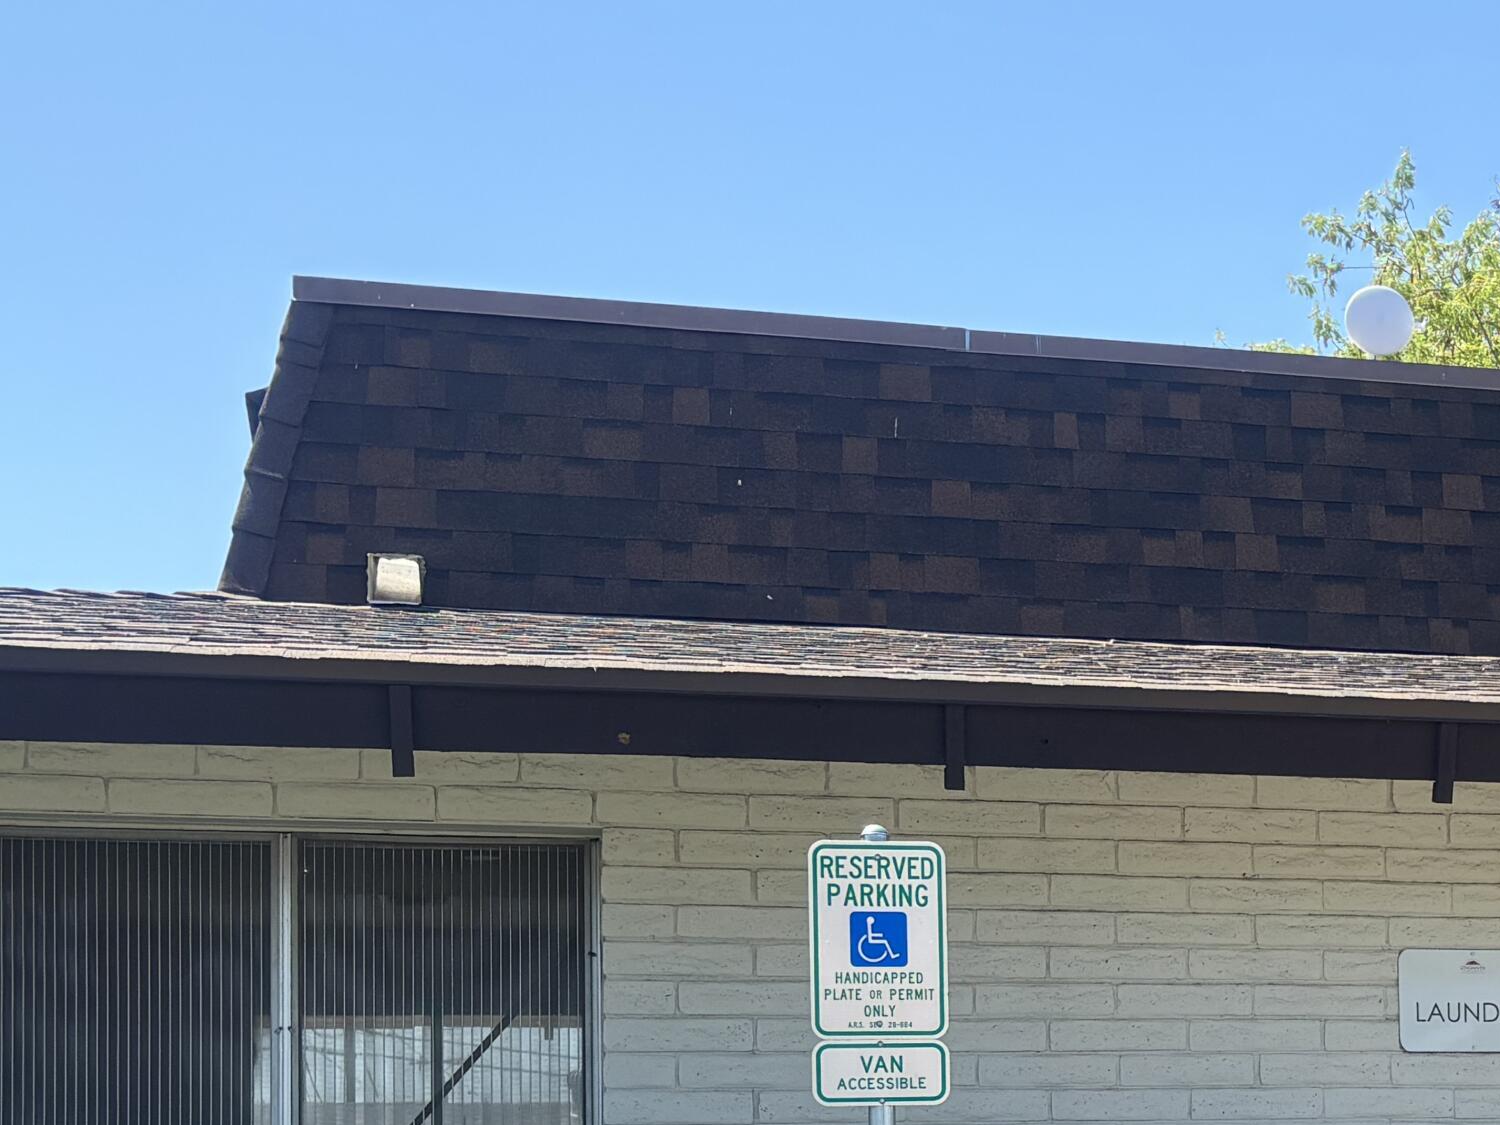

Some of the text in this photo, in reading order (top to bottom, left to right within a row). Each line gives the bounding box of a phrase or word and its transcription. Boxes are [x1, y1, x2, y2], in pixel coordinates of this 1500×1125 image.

[820, 855, 935, 880] RESERVED
[827, 883, 929, 908] PARKING
[835, 972, 924, 985] HANDICAPPED
[824, 988, 935, 1001] PLATE OR PERMIT
[864, 1005, 896, 1018] ONLY
[860, 1055, 904, 1074] VAN
[837, 1077, 927, 1091] ACCESSIBLE
